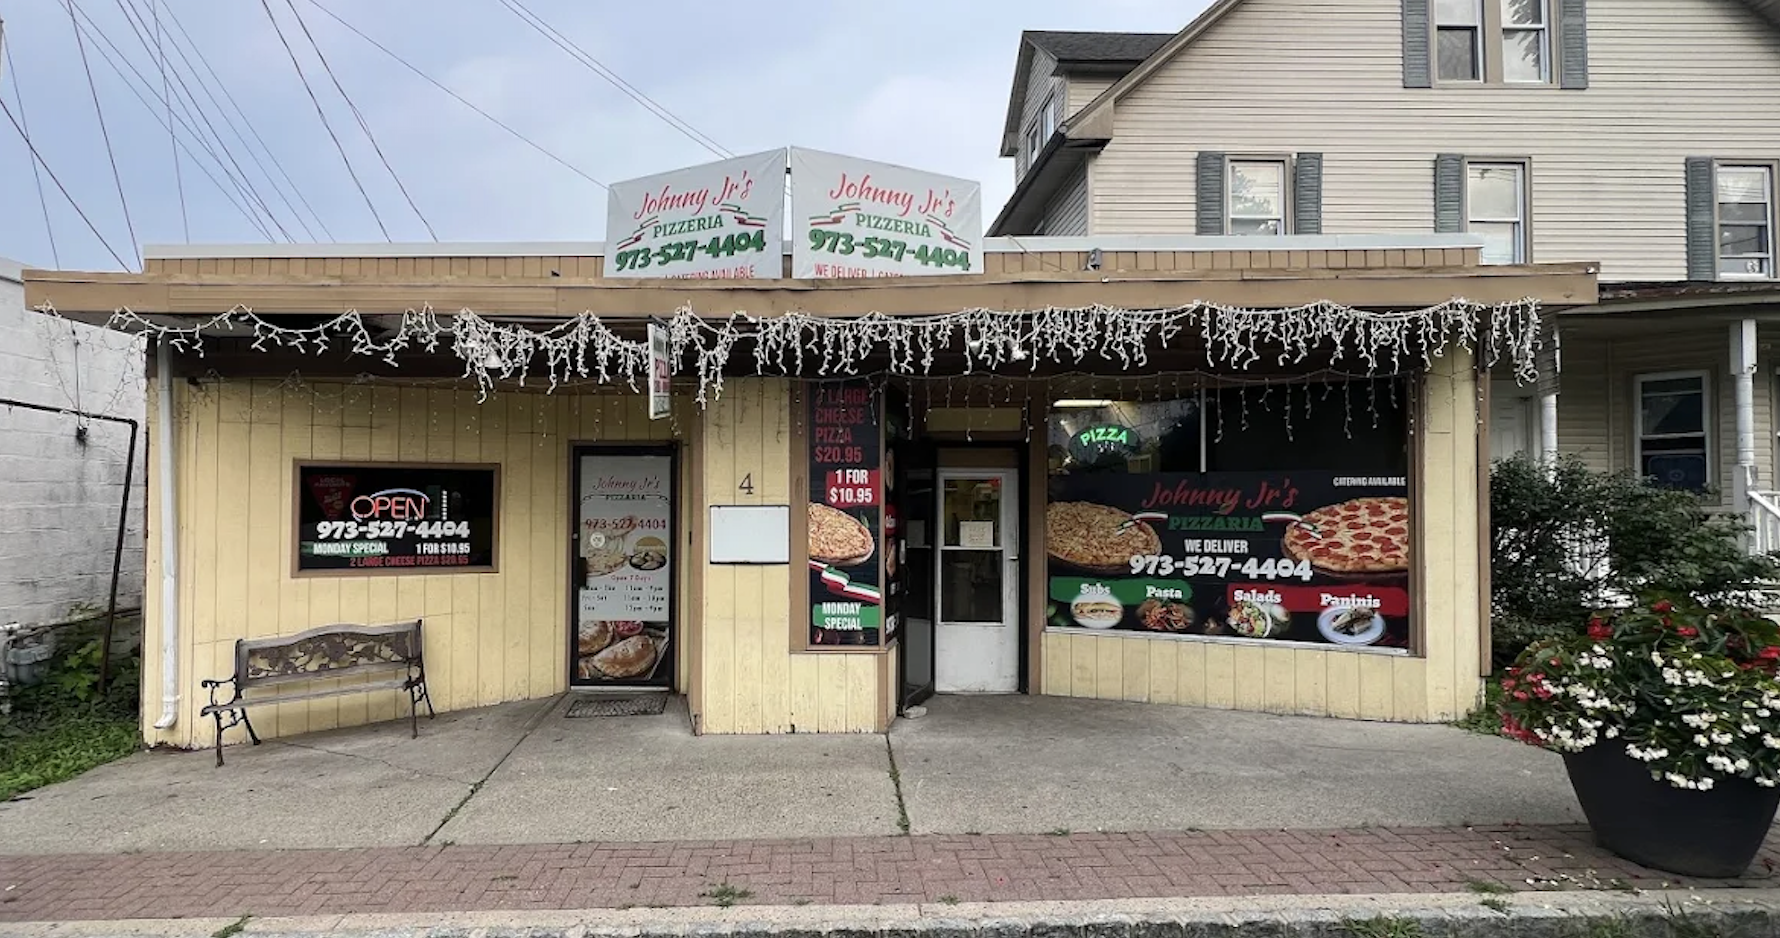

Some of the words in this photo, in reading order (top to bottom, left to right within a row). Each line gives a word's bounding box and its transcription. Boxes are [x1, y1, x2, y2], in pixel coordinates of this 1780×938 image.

[634, 185, 709, 219] Johnny
[712, 170, 753, 206] Jr's
[829, 173, 914, 217] Johnny
[917, 189, 956, 217] Jr's
[653, 214, 724, 239] PIZZERIA
[855, 212, 932, 238] PIZZERIA
[615, 229, 766, 272] 973-527-4404
[808, 229, 971, 271] 973-527-4404
[814, 263, 829, 277] WE
[815, 407, 865, 425] CHEESE
[1080, 427, 1127, 447] PIZZA
[815, 446, 863, 464] $20.95
[593, 475, 637, 492] Johnny
[639, 475, 660, 490] Jr's
[739, 472, 754, 495] 4
[835, 470, 842, 485] 1
[845, 470, 869, 485] FOR
[829, 488, 873, 504] $10.95
[1141, 479, 1241, 515] Johnny
[1246, 478, 1299, 509] Jr's
[350, 495, 425, 519] OPEN
[316, 521, 470, 540] 973-527-4404
[585, 518, 666, 530] 973-527-4404
[1168, 516, 1264, 531] PIZZARIA
[313, 542, 351, 555] MONDAY
[352, 542, 389, 555] SPECIAL
[416, 543, 422, 554] 1
[422, 543, 440, 554] FOR
[1184, 539, 1202, 553] WE
[1203, 539, 1249, 554] DELIVER
[350, 556, 356, 568] 2
[385, 555, 415, 567] CHEESE
[1129, 555, 1313, 581] 973-527-4404
[1080, 583, 1110, 595] Subs
[1146, 585, 1182, 599] Pasta
[1233, 589, 1282, 604] Salads
[1320, 593, 1381, 608] Paninis
[822, 602, 861, 616] MONDAY
[824, 616, 863, 631] SPECIAL
